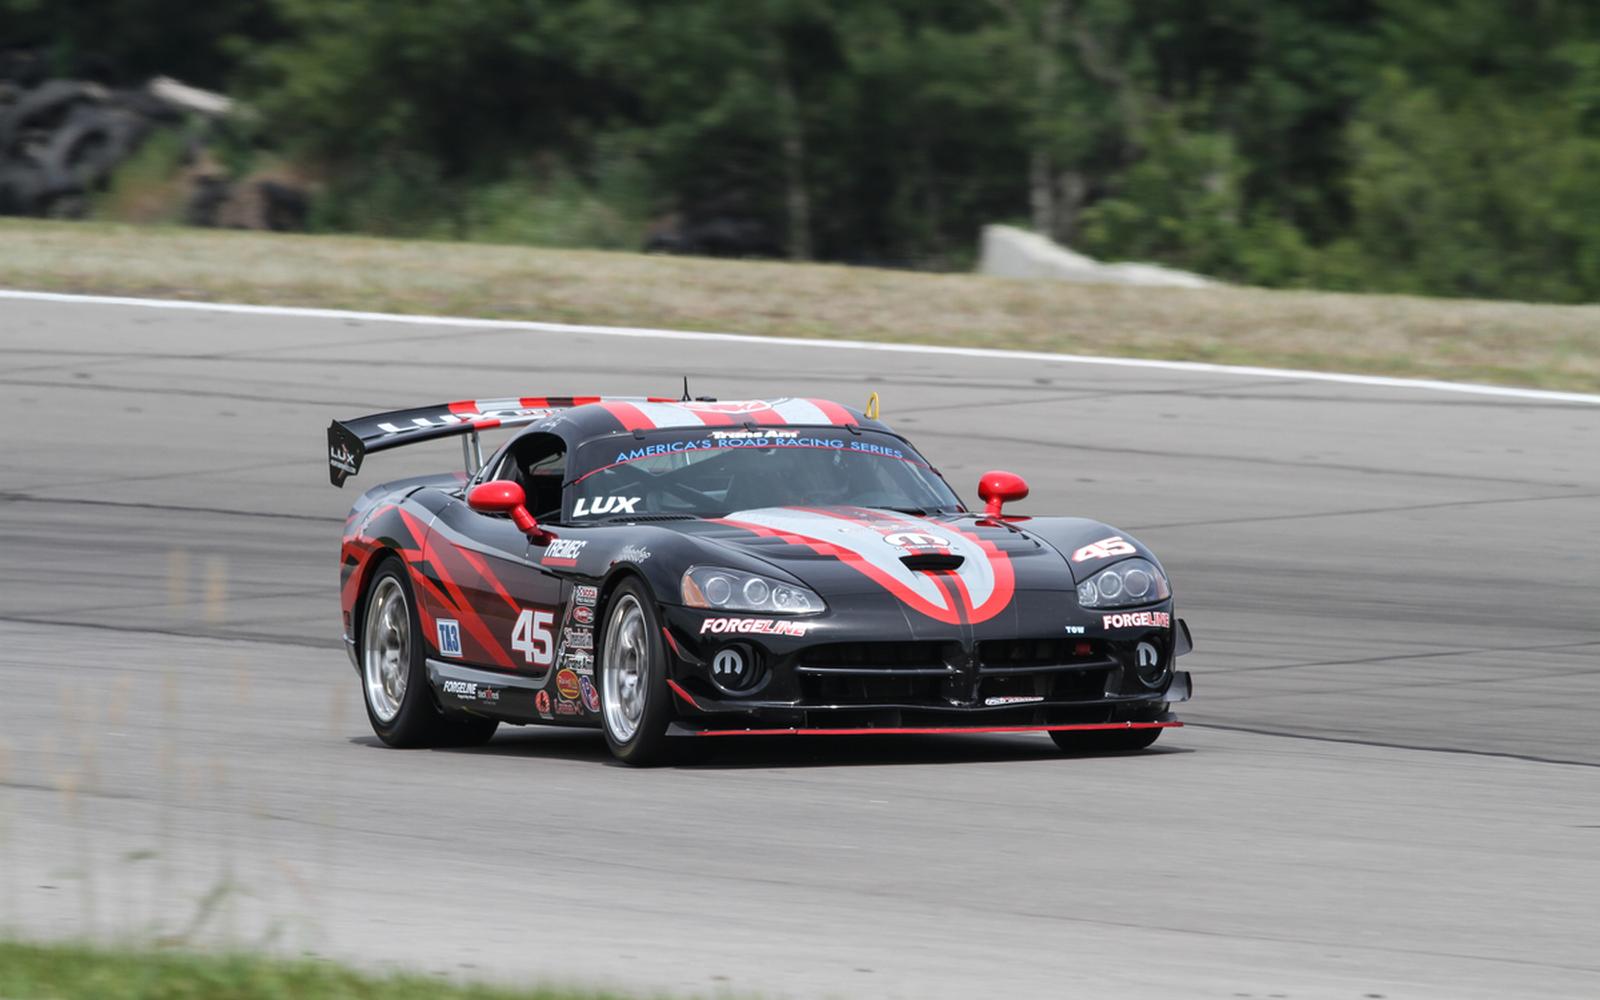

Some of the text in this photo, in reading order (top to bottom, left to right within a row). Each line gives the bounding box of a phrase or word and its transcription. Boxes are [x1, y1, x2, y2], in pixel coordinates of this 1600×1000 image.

[376, 410, 504, 434] LUX
[765, 430, 798, 439] Am
[330, 446, 355, 465] LUX
[615, 437, 904, 463] AMERICA'S ROAD RACING SERIES
[572, 495, 641, 518] LUX
[543, 539, 588, 559] TREMEC
[1071, 536, 1137, 562] 45
[700, 617, 808, 637] FORGELINE
[1065, 626, 1085, 634] TOW
[1102, 611, 1170, 630] FORGELINE
[439, 624, 460, 653] TA3
[511, 609, 554, 665] 45
[443, 680, 478, 695] FORGELINE
